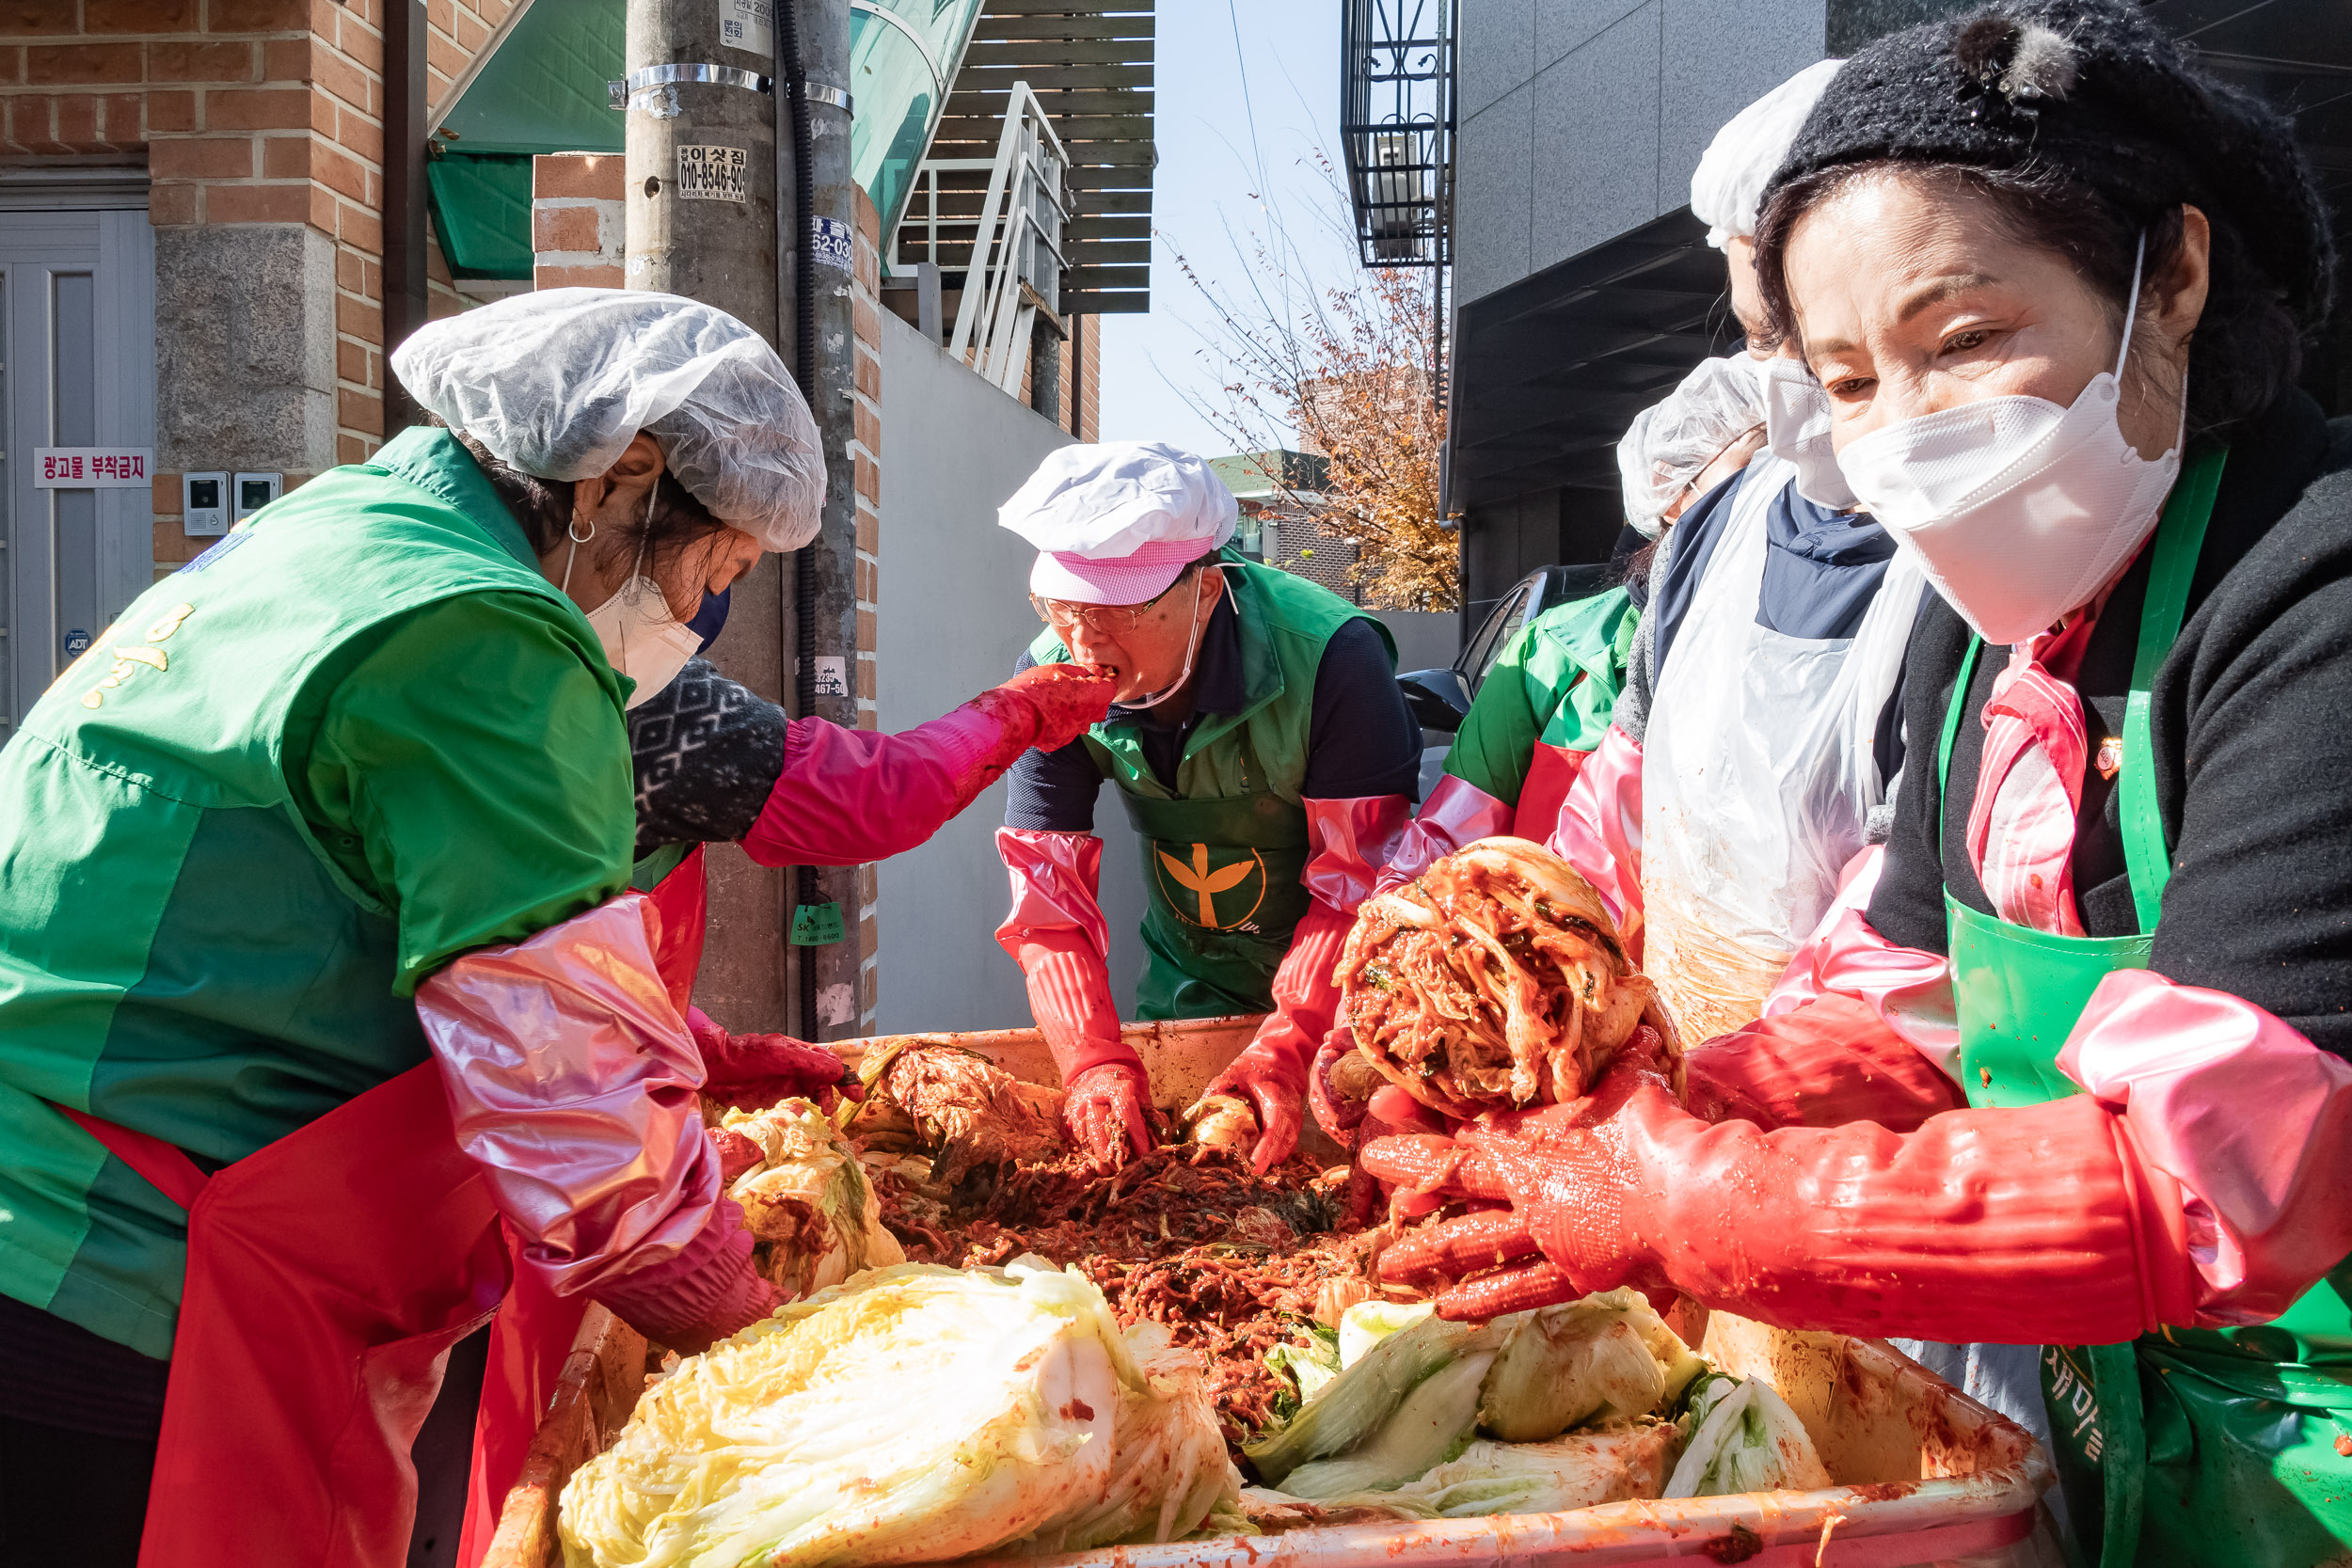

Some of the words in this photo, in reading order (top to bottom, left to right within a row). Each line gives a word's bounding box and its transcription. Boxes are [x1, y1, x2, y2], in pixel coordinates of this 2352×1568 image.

[44, 456, 83, 480] 광고물
[92, 455, 143, 480] 부착금지
[69, 639, 87, 649] ADT
[798, 923, 809, 931] SK
